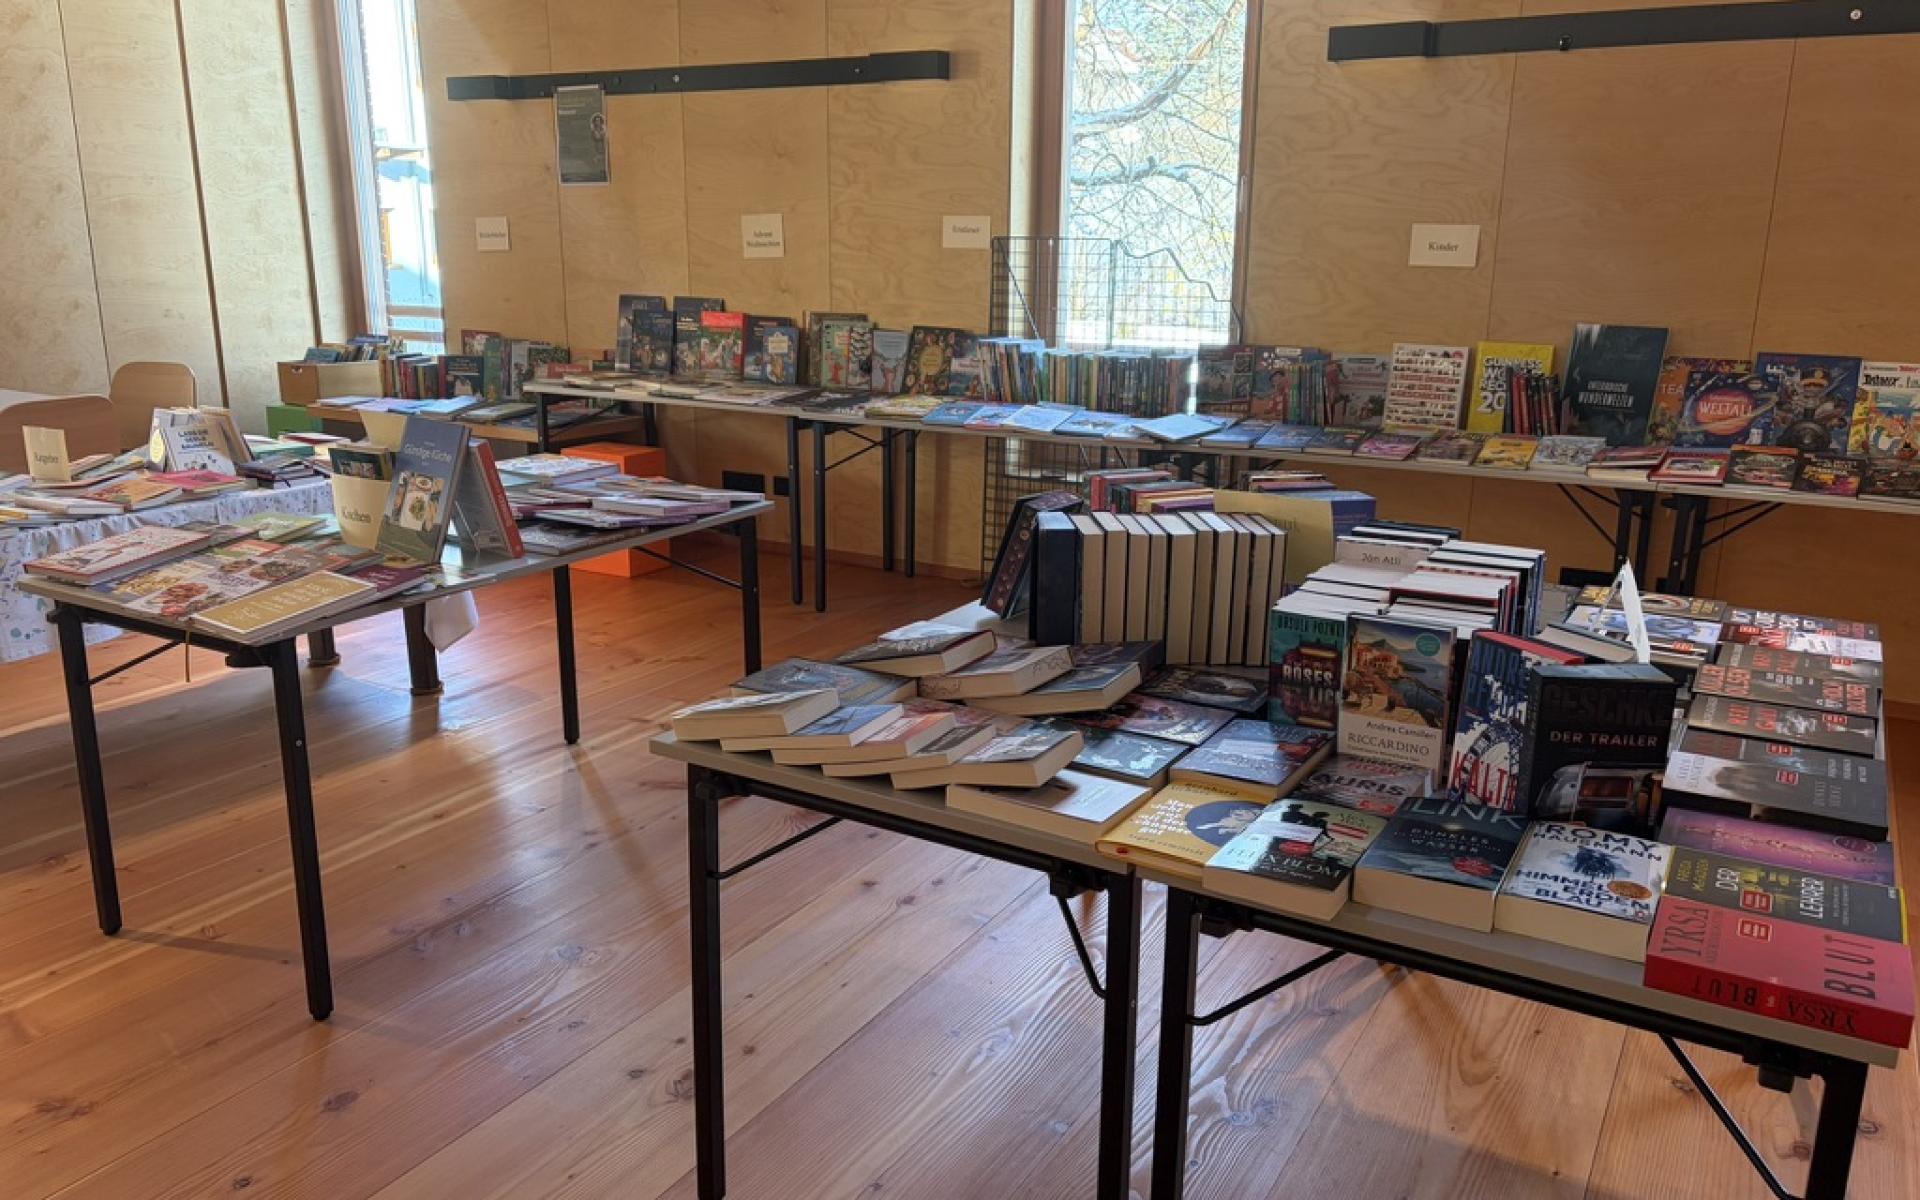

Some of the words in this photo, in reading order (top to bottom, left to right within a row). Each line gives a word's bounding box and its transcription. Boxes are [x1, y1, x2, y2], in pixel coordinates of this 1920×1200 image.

[1428, 241, 1459, 251] Kinder
[1699, 400, 1753, 417] WELTALL
[1366, 721, 1396, 733] Andrea
[1550, 730, 1583, 744] DER
[1589, 732, 1658, 747] TRAILER
[1348, 733, 1429, 755] RICCARDINO
[1534, 832, 1662, 861] HAUSMANN
[1546, 823, 1656, 851] ROMY
[1715, 867, 1740, 891] DER
[1800, 876, 1824, 919] LEHRER
[1660, 904, 1709, 956] YRSA
[1824, 934, 1875, 1000] BLUT
[1693, 974, 1758, 1008] BLUT
[1788, 1001, 1857, 1034] YRSA
